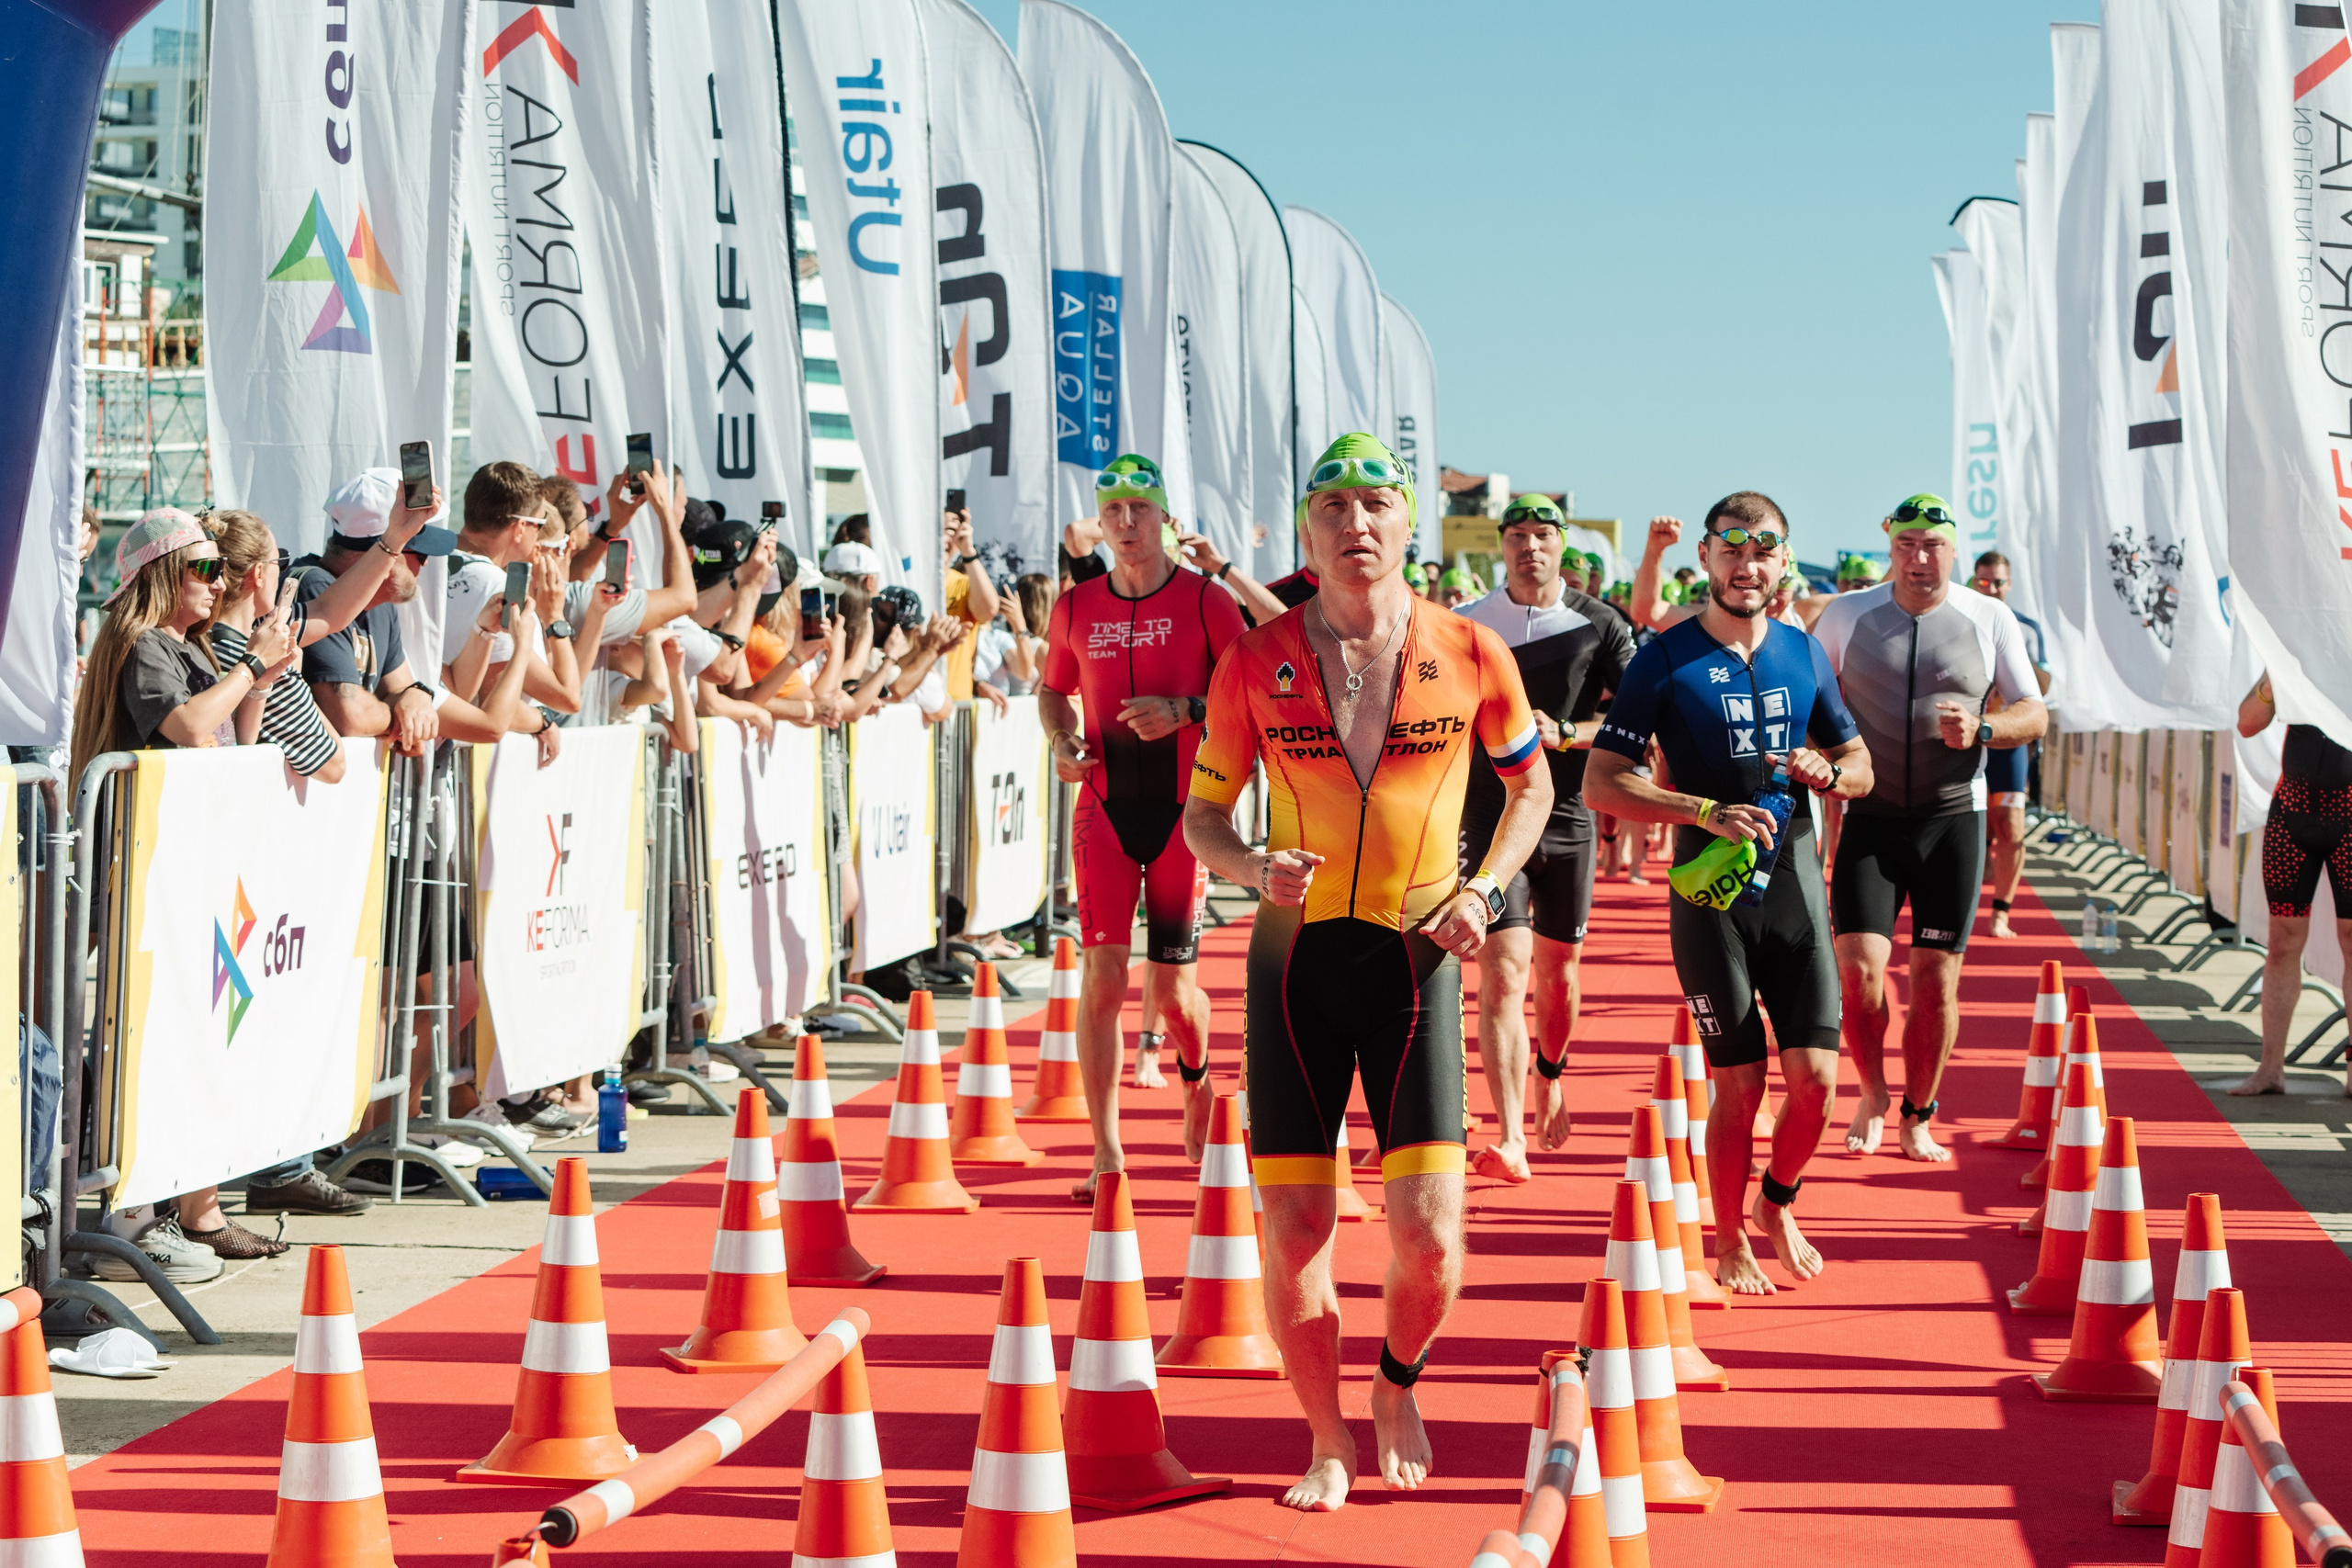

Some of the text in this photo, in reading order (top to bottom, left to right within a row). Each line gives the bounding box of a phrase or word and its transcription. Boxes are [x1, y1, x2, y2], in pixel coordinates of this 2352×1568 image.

[1091, 617, 1171, 634] TIME TO
[1087, 630, 1172, 649] SPORT
[1087, 650, 1117, 660] TEAM
[1617, 727, 1651, 747] NEX
[738, 843, 796, 889] EXEED
[527, 903, 591, 953] KEFORMA
[264, 912, 306, 978] сбп
